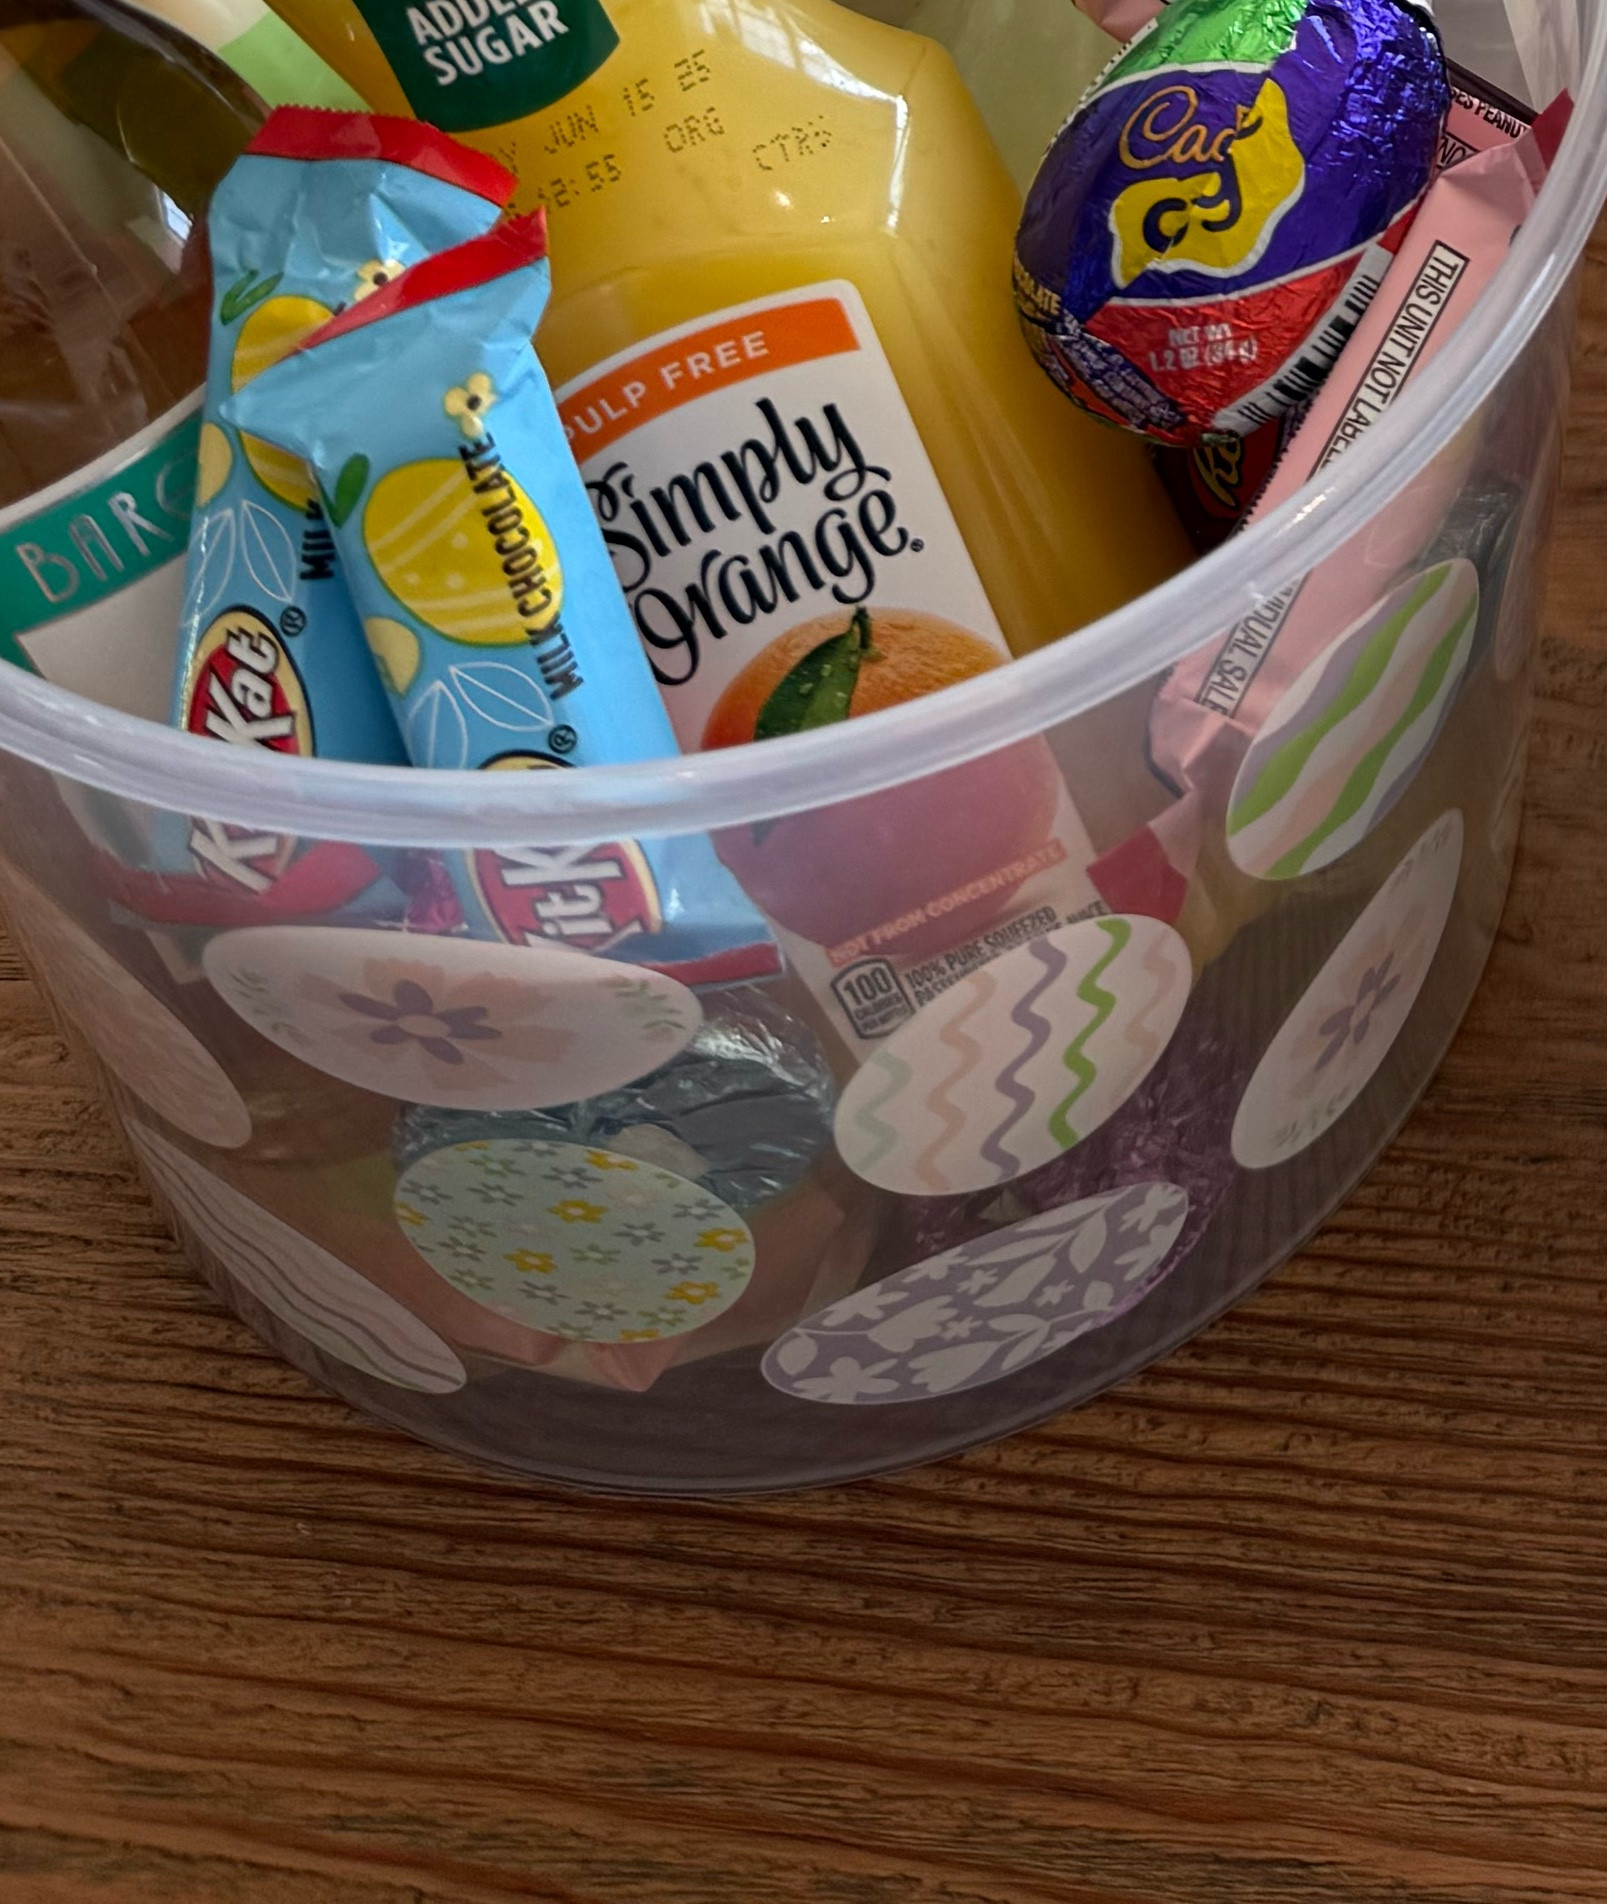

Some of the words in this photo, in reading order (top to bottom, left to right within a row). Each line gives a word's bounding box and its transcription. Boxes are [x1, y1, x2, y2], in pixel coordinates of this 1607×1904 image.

[422, 0, 570, 86] SUGAR
[544, 104, 599, 154] JUN
[624, 78, 655, 117] 15
[1415, 256, 1459, 306] THIS
[658, 331, 770, 391] FREE
[1389, 303, 1434, 358] UNIT
[1364, 351, 1406, 404] NOT
[458, 432, 553, 619] CHOCOLATE
[586, 397, 892, 592] Simply
[630, 489, 909, 686] Orange
[528, 612, 585, 701] MILK
[843, 966, 894, 1006] 100
